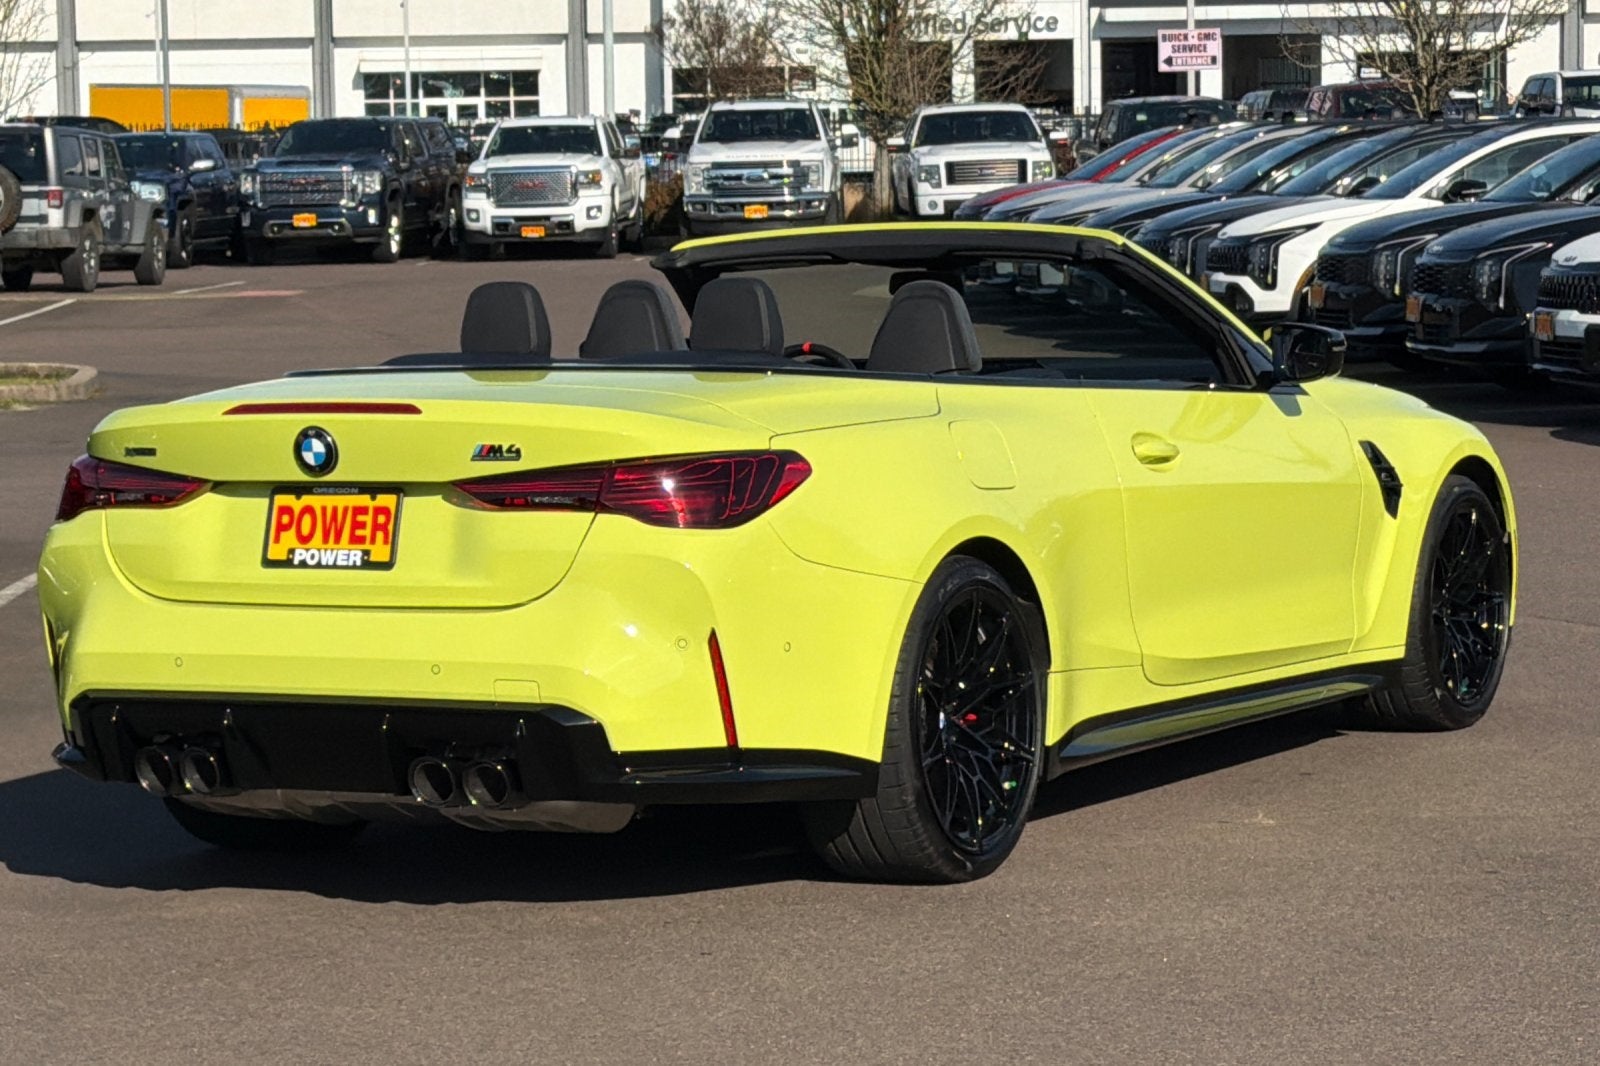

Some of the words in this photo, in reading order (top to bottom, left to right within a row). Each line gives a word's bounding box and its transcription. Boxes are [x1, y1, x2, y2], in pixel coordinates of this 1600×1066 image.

[975, 13, 1059, 33] Service
[1161, 32, 1189, 43] BUICK
[1197, 32, 1218, 42] GMC
[1171, 44, 1208, 53] SERVICE
[1172, 56, 1212, 66] ENTRANCE
[480, 443, 522, 461] M4
[273, 505, 392, 545] POWER
[293, 548, 363, 566] POWER
